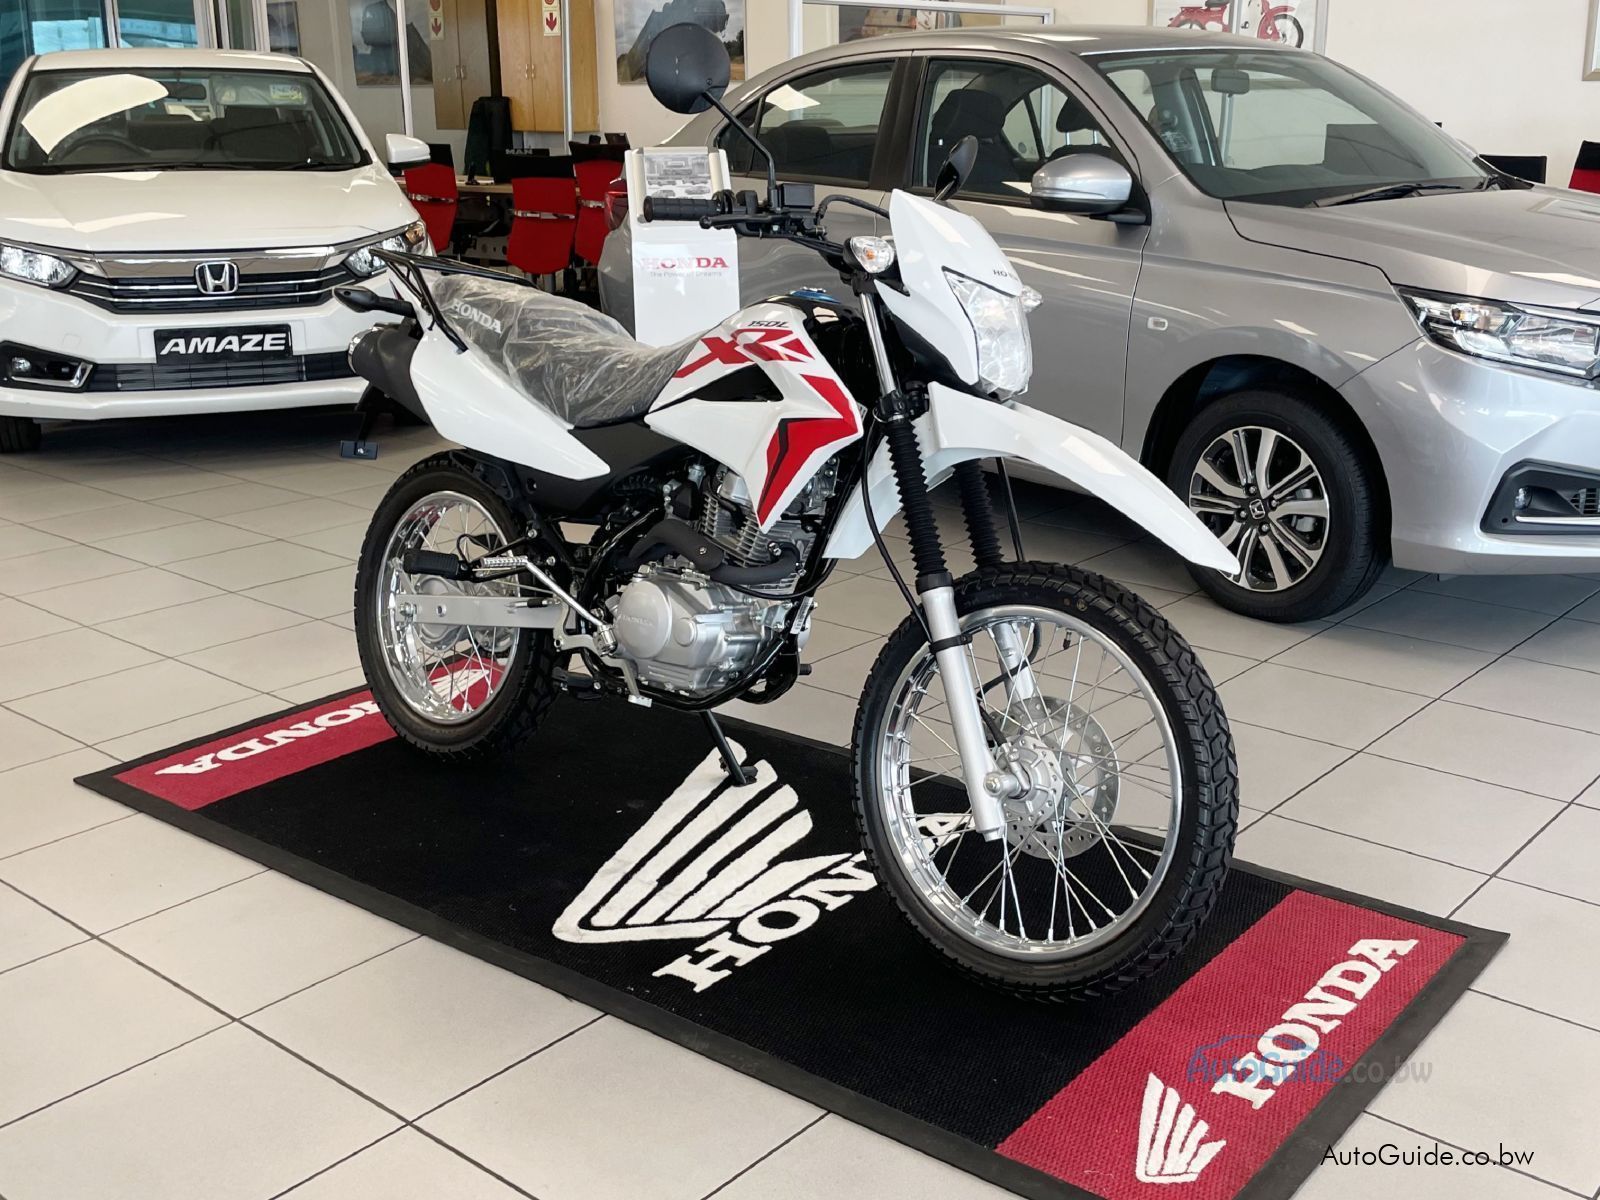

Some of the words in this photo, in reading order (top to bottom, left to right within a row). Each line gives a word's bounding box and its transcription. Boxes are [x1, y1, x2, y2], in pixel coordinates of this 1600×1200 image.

[450, 298, 502, 333] HONDA
[160, 333, 287, 355] AMAZE
[1210, 938, 1420, 1111] HONDA
